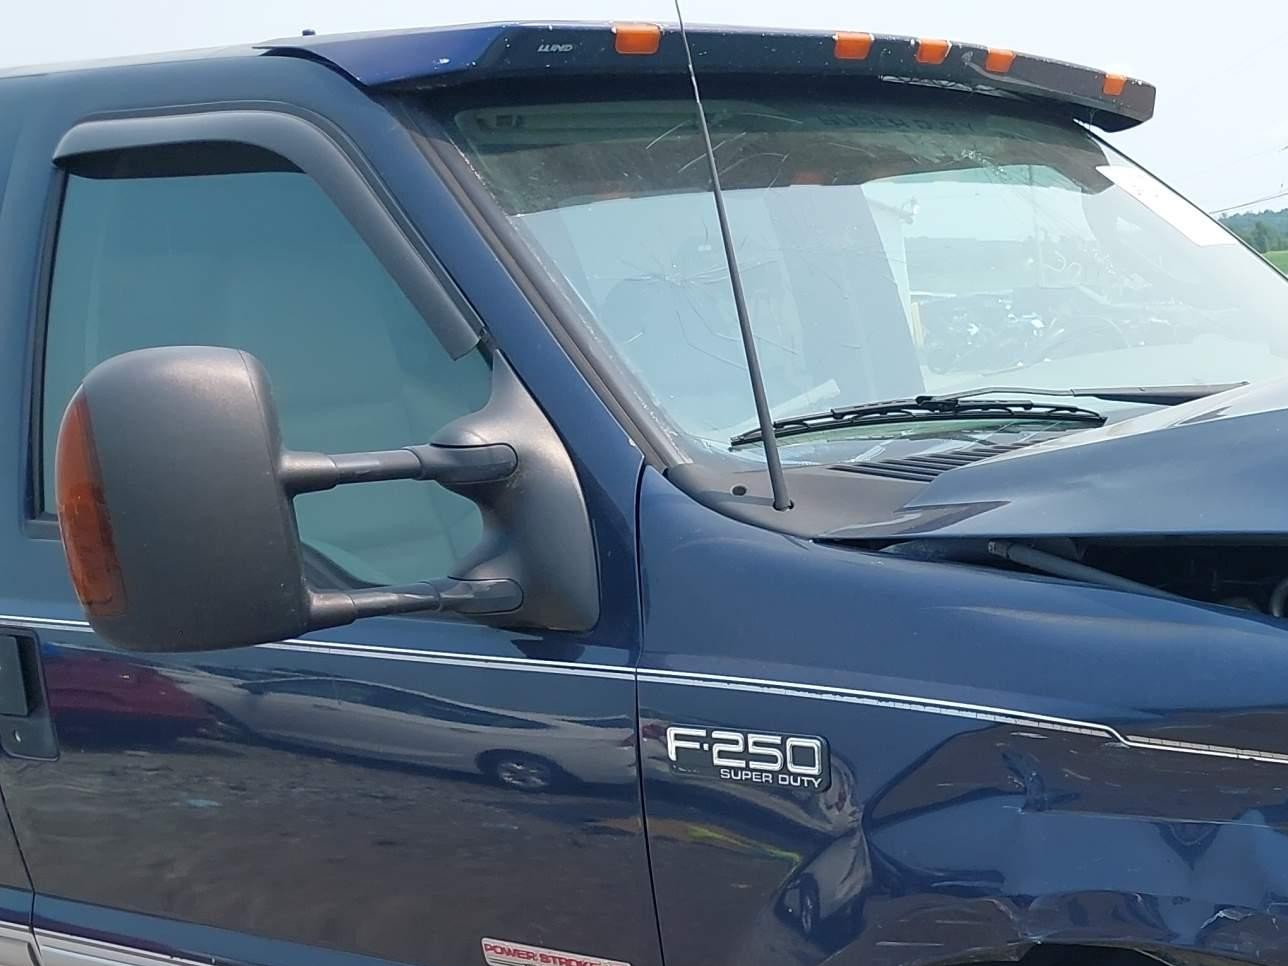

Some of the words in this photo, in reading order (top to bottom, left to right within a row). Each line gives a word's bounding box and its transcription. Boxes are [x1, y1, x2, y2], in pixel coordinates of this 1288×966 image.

[666, 726, 822, 775] F-250
[720, 768, 773, 784] SUPER
[778, 774, 822, 788] DUTY
[484, 943, 538, 961] POWER
